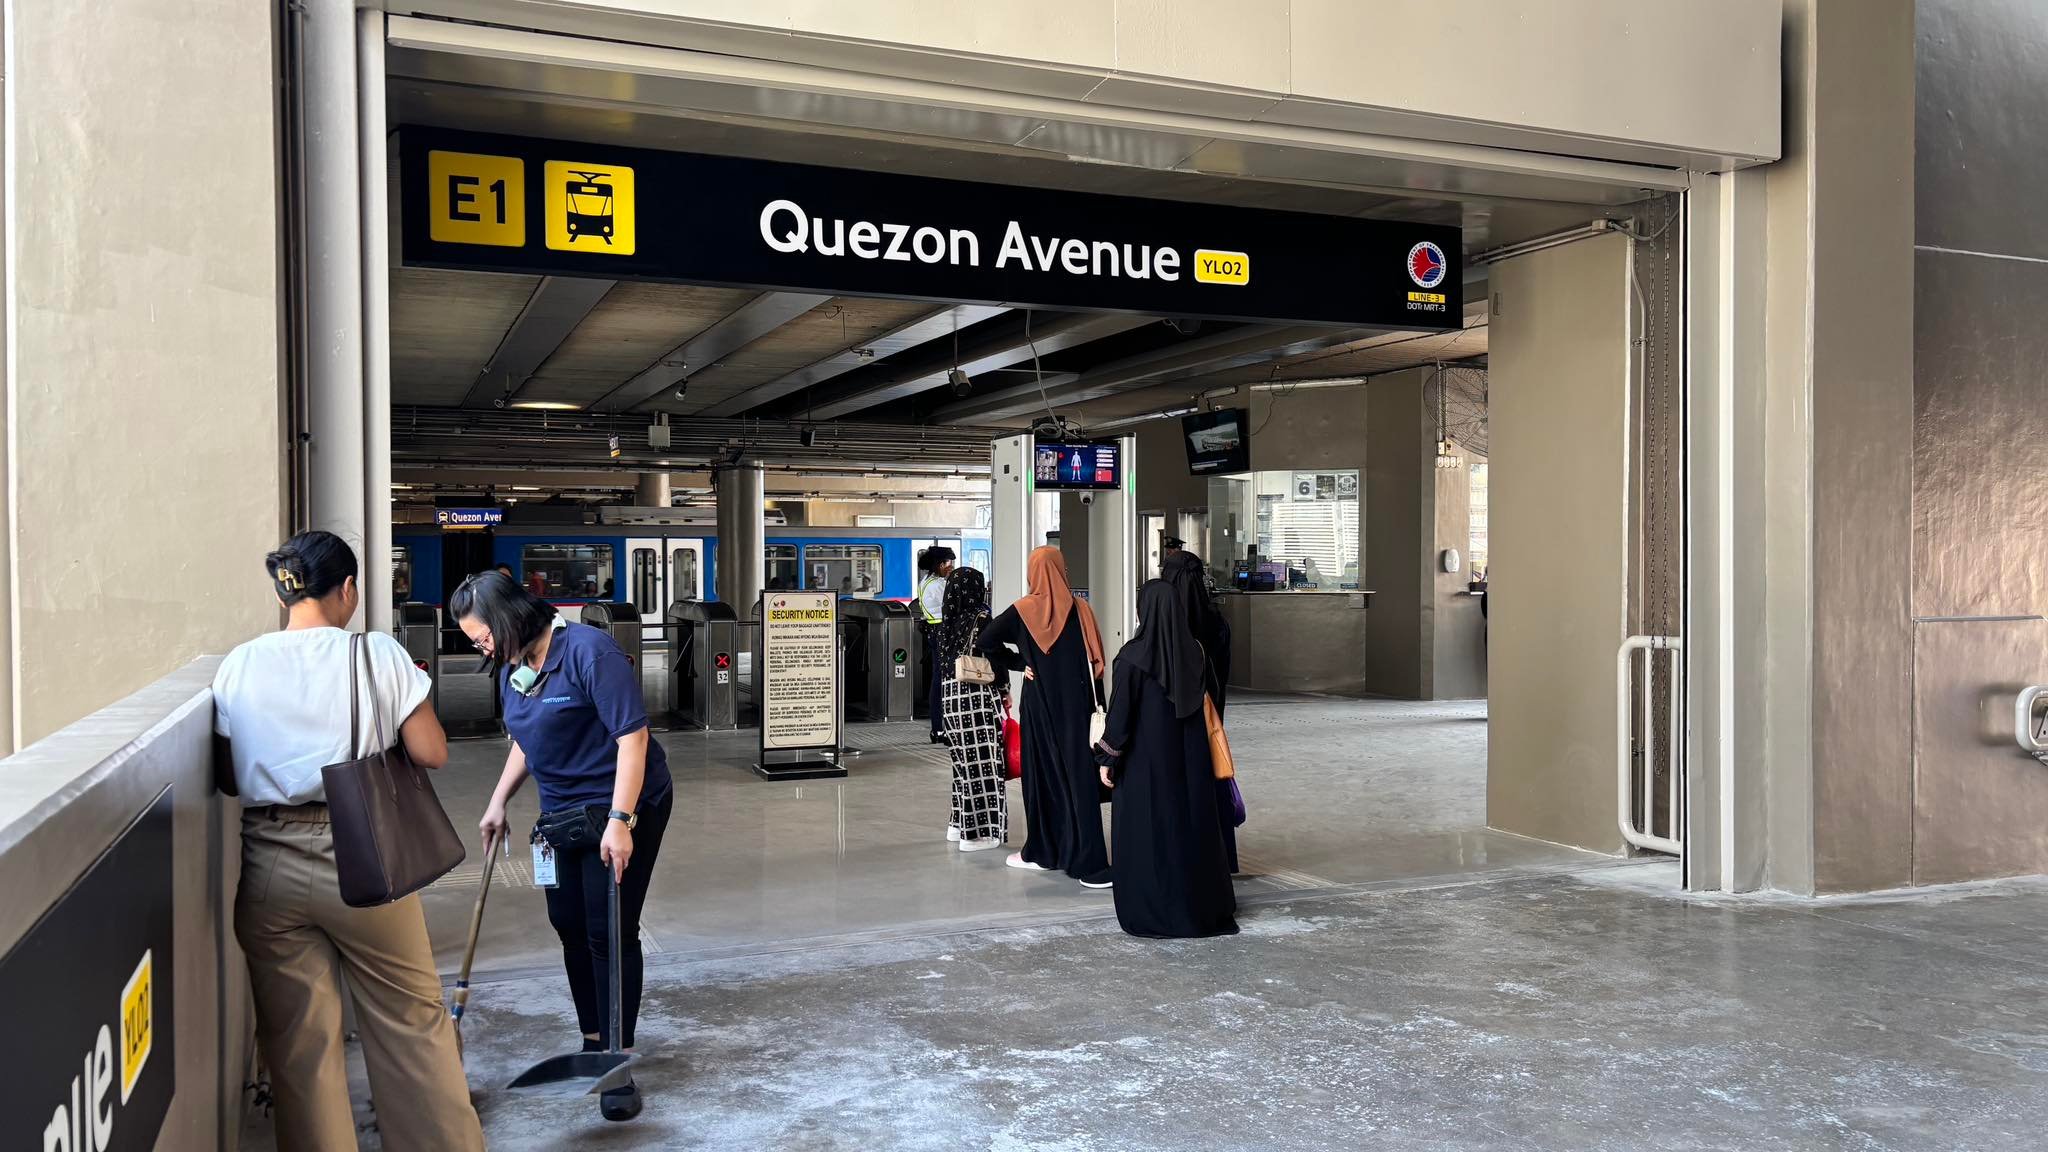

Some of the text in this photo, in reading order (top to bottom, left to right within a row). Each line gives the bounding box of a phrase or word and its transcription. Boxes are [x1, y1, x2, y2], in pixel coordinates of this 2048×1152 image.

[448, 175, 506, 225] E1
[760, 200, 1181, 282] Quezon Avenue
[1413, 293, 1440, 302] LINE-3
[1423, 303, 1446, 312] MRT-3
[1298, 481, 1310, 496] 6
[451, 512, 482, 524] Quezon
[772, 609, 829, 620] SECURITY NOTICE
[895, 667, 905, 676] 34
[718, 673, 728, 682] 32
